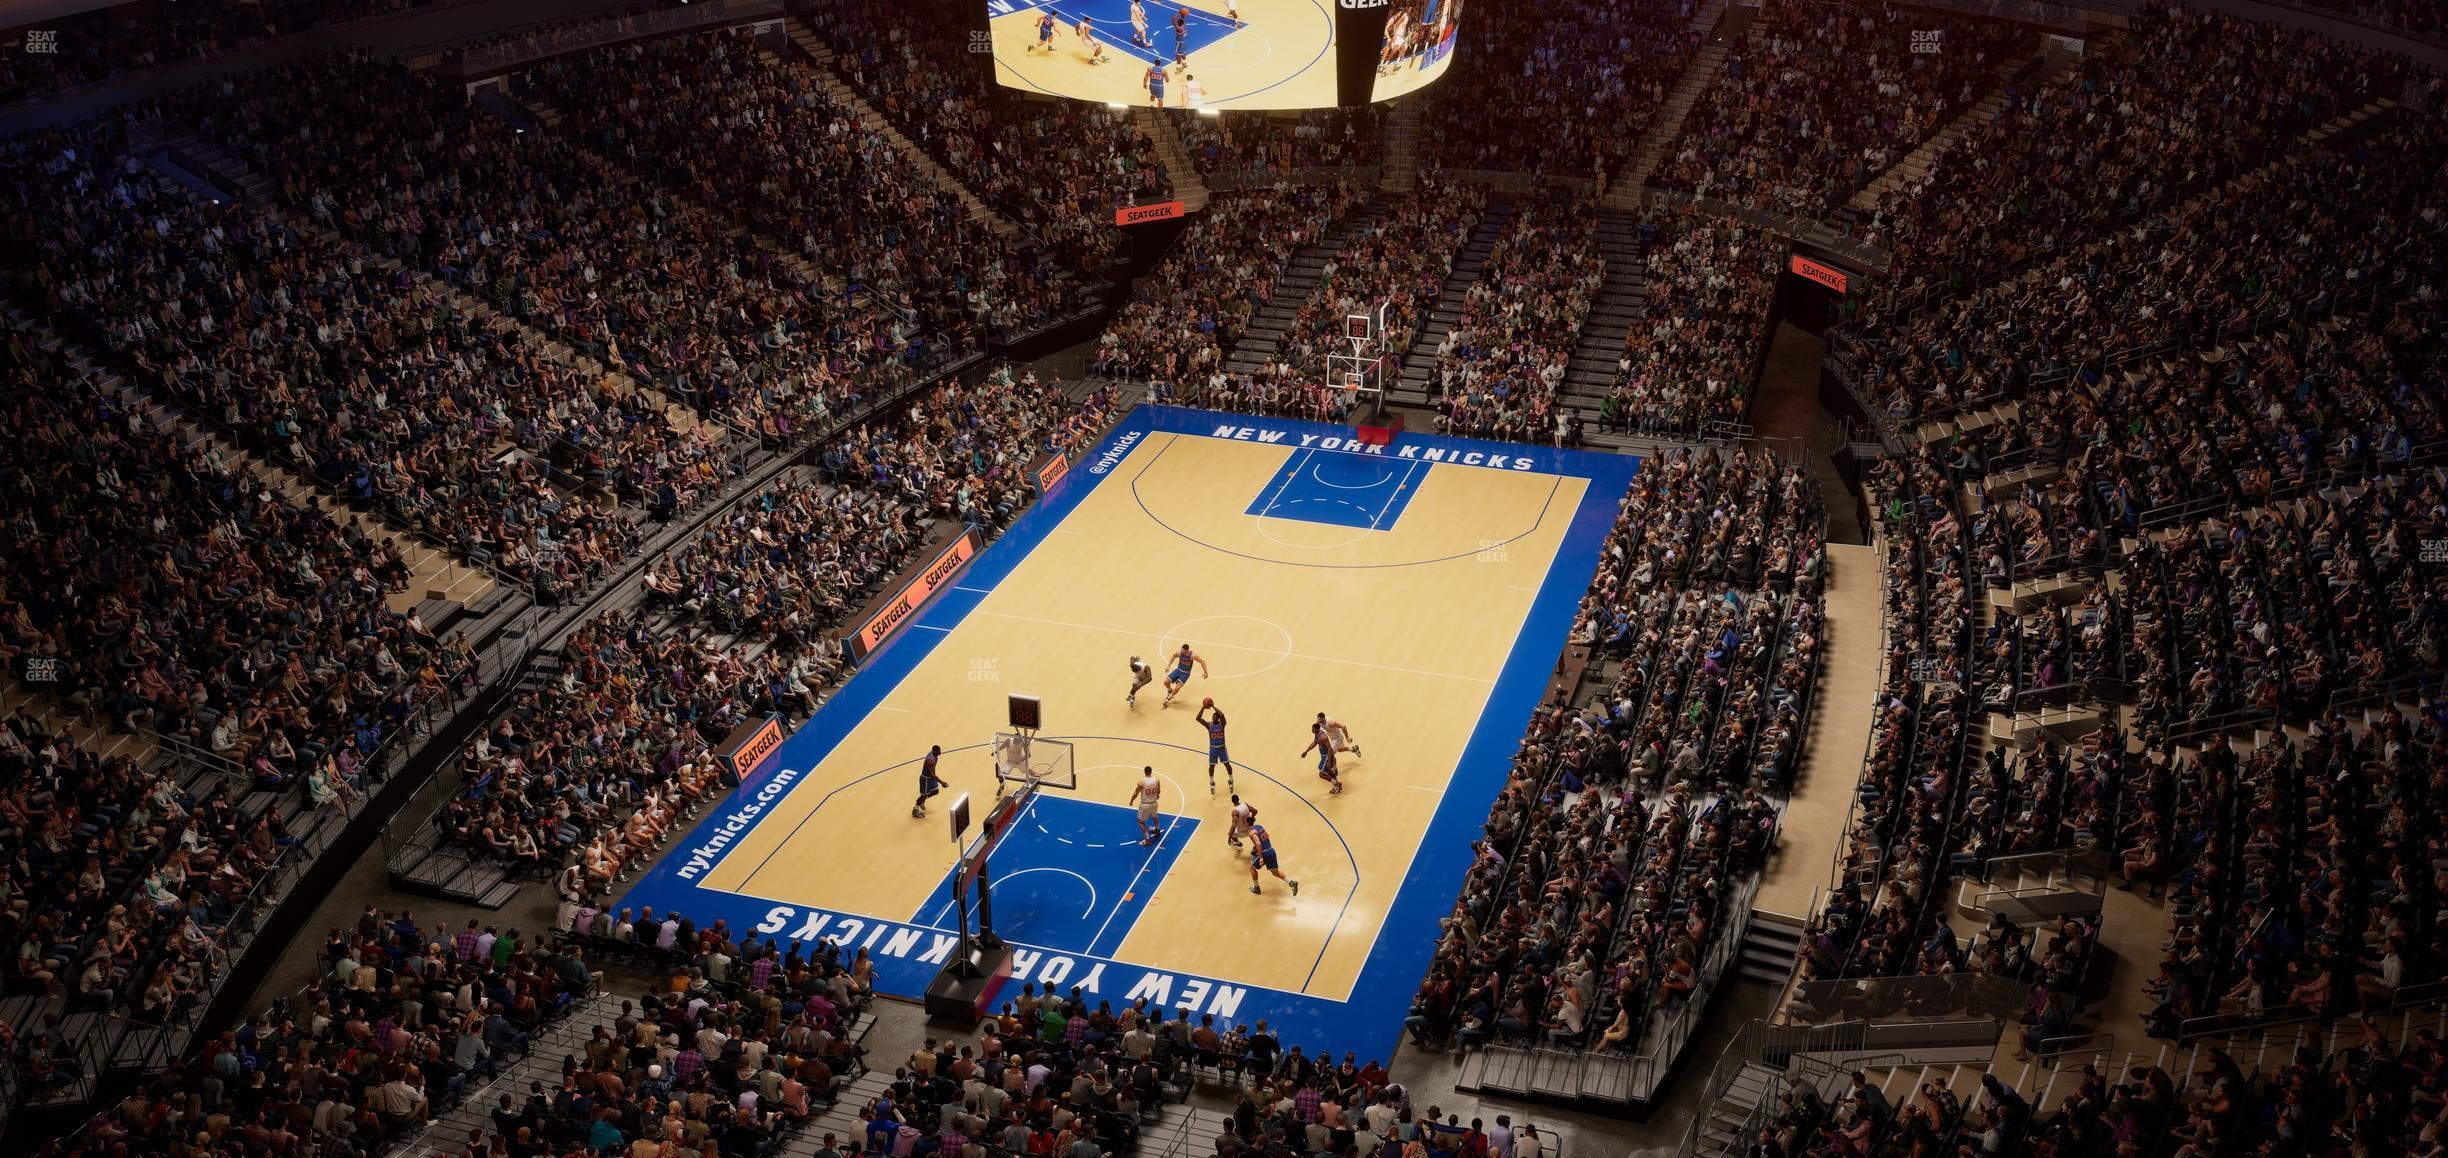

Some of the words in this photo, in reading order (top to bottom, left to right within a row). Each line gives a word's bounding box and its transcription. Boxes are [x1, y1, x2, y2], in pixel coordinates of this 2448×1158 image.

[1127, 206, 1173, 222] SEATGEEK
[1801, 263, 1839, 288] SEATGEEK
[1089, 431, 1142, 475] @nyknicks
[1212, 425, 1287, 443] NEW
[1300, 434, 1385, 455] YORK
[1398, 445, 1535, 471] KNICKS
[1041, 457, 1068, 488] SEATGEEK
[925, 547, 963, 592] SEATGEEK
[871, 595, 912, 642] SEATGEEK
[738, 725, 780, 773] SEATGEEK
[676, 769, 798, 879] nyknicks.com
[756, 906, 959, 963] KNICKS
[1010, 948, 1107, 993] YOR
[1124, 972, 1247, 1018] NEW
